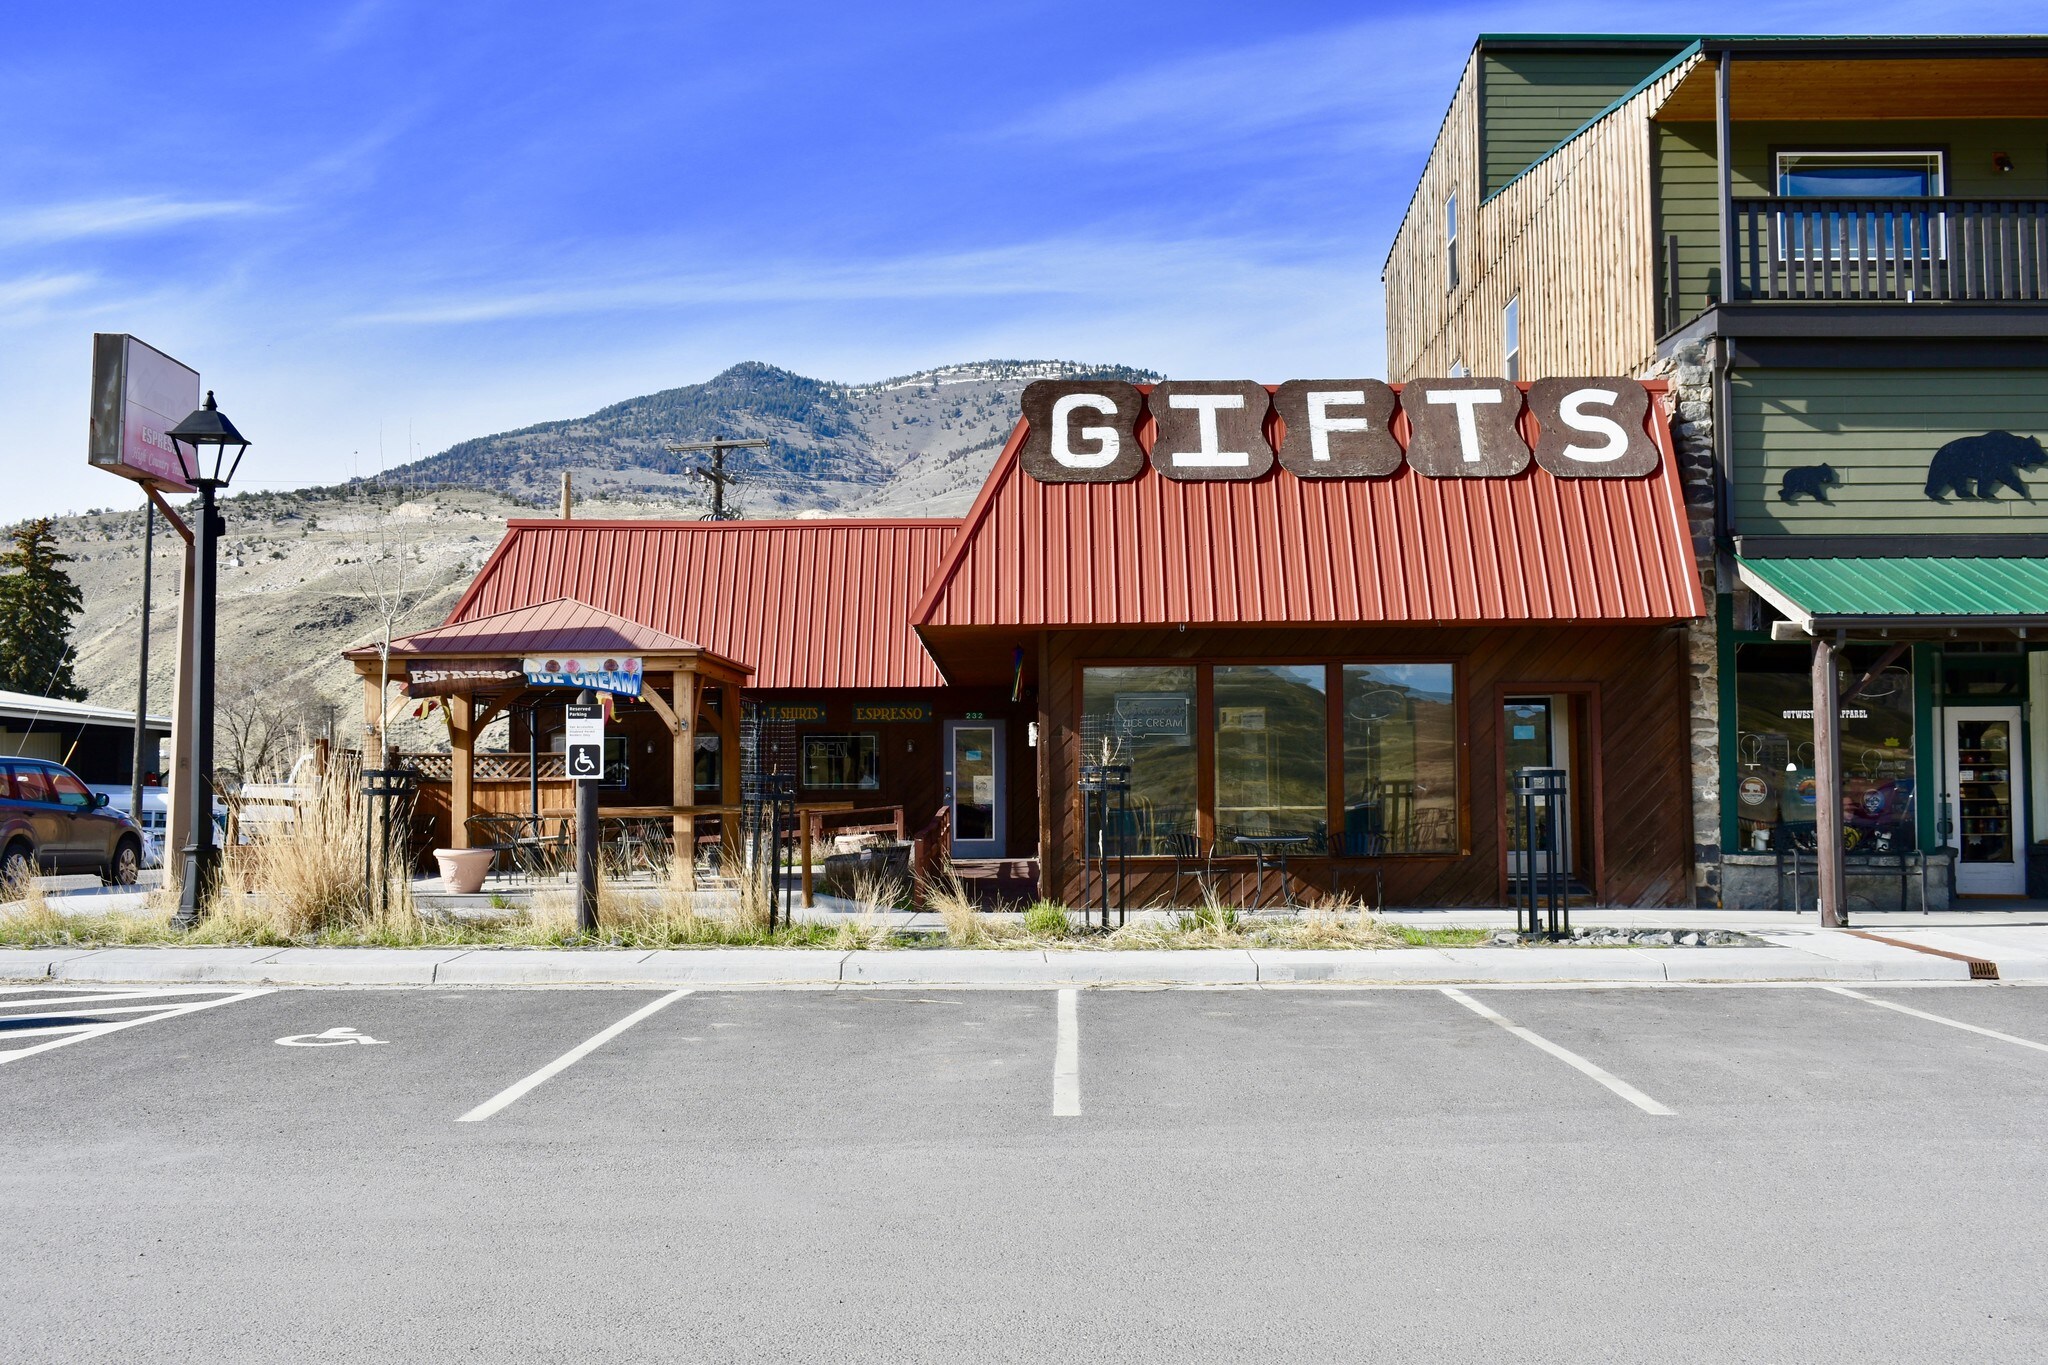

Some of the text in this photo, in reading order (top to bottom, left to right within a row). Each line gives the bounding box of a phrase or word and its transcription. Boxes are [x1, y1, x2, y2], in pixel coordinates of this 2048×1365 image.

[1051, 388, 1629, 468] GIFTS
[410, 670, 521, 684] ESPRESSO
[530, 671, 639, 695] ICE CREAM
[856, 707, 923, 720] ESPRESSO
[1782, 710, 1868, 719] OUTWEST PPAREL
[1145, 718, 1183, 728] CREAM
[805, 742, 847, 758] OPEN
